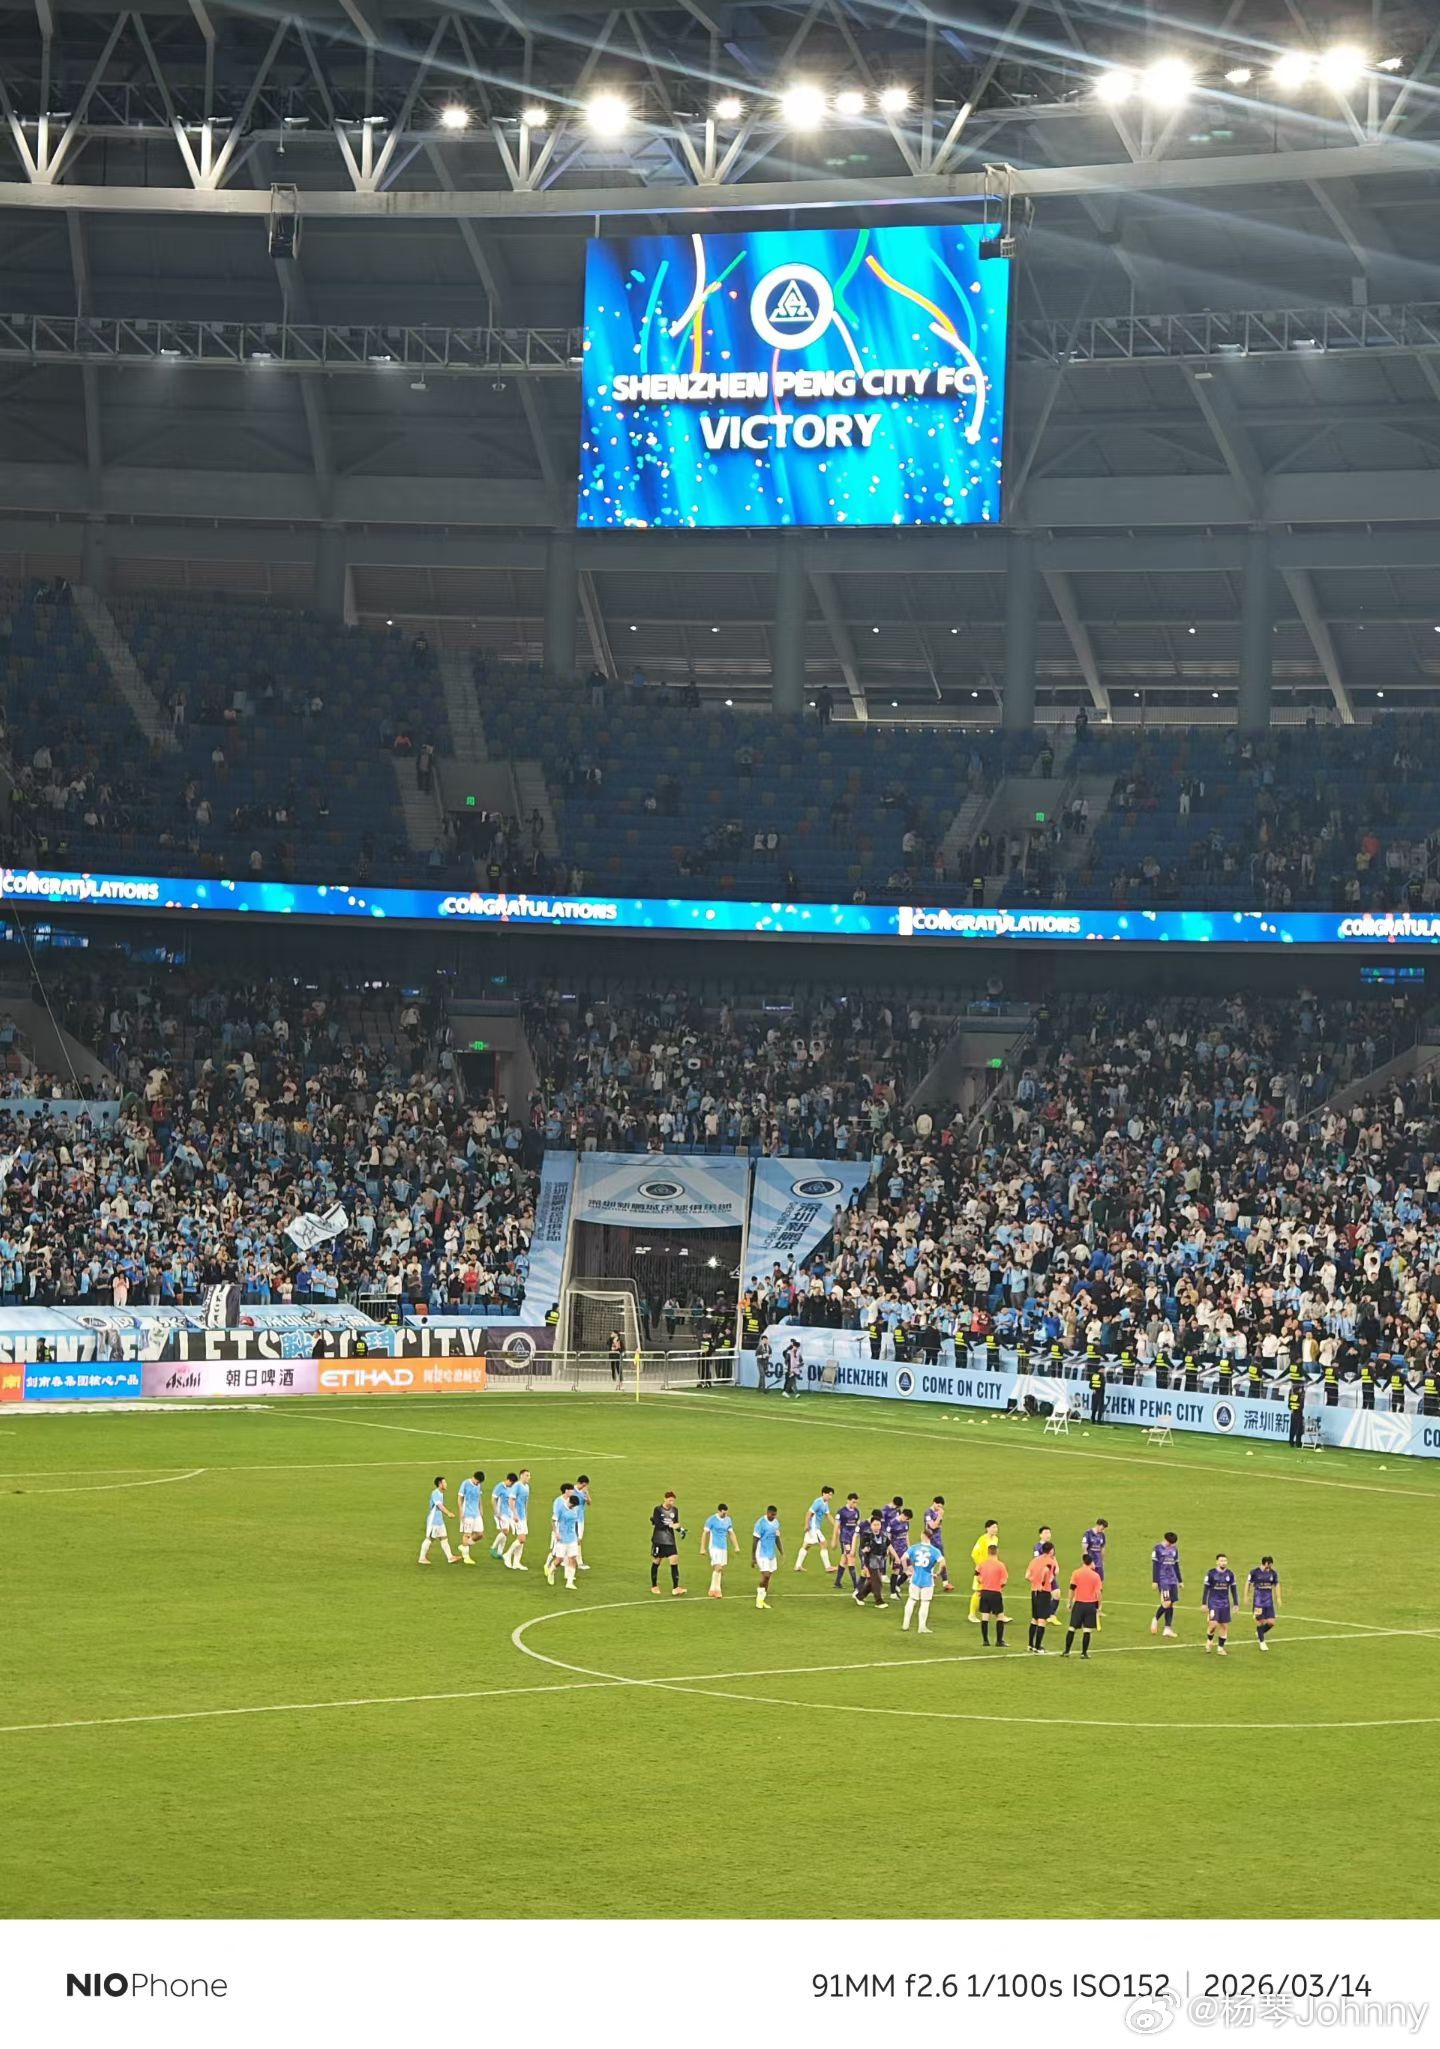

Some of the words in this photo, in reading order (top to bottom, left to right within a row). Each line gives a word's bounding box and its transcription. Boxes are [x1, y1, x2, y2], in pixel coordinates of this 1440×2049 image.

[611, 371, 768, 400] SHENZHEN
[774, 370, 856, 398] PENG
[862, 368, 933, 396] CITY
[936, 367, 984, 394] FC
[699, 413, 882, 450] VICTORY
[2, 873, 159, 900] CONGRATULATIONS
[444, 895, 617, 920] CONGRATULATIONS
[912, 913, 1080, 935] CONGRATULATIONS
[394, 1328, 483, 1357] CITY
[166, 1372, 200, 1389] Asahi
[226, 1369, 294, 1387] 朝日啤酒
[320, 1368, 414, 1388] ETIHAD
[833, 1365, 888, 1388] HENZHEN
[922, 1375, 953, 1395] COME
[957, 1380, 973, 1397] ON
[977, 1382, 1002, 1400] CITY
[1074, 1391, 1135, 1417] SHZHEN
[1139, 1399, 1172, 1417] PENG
[1176, 1403, 1204, 1423] CITY
[914, 1551, 931, 1568] 36
